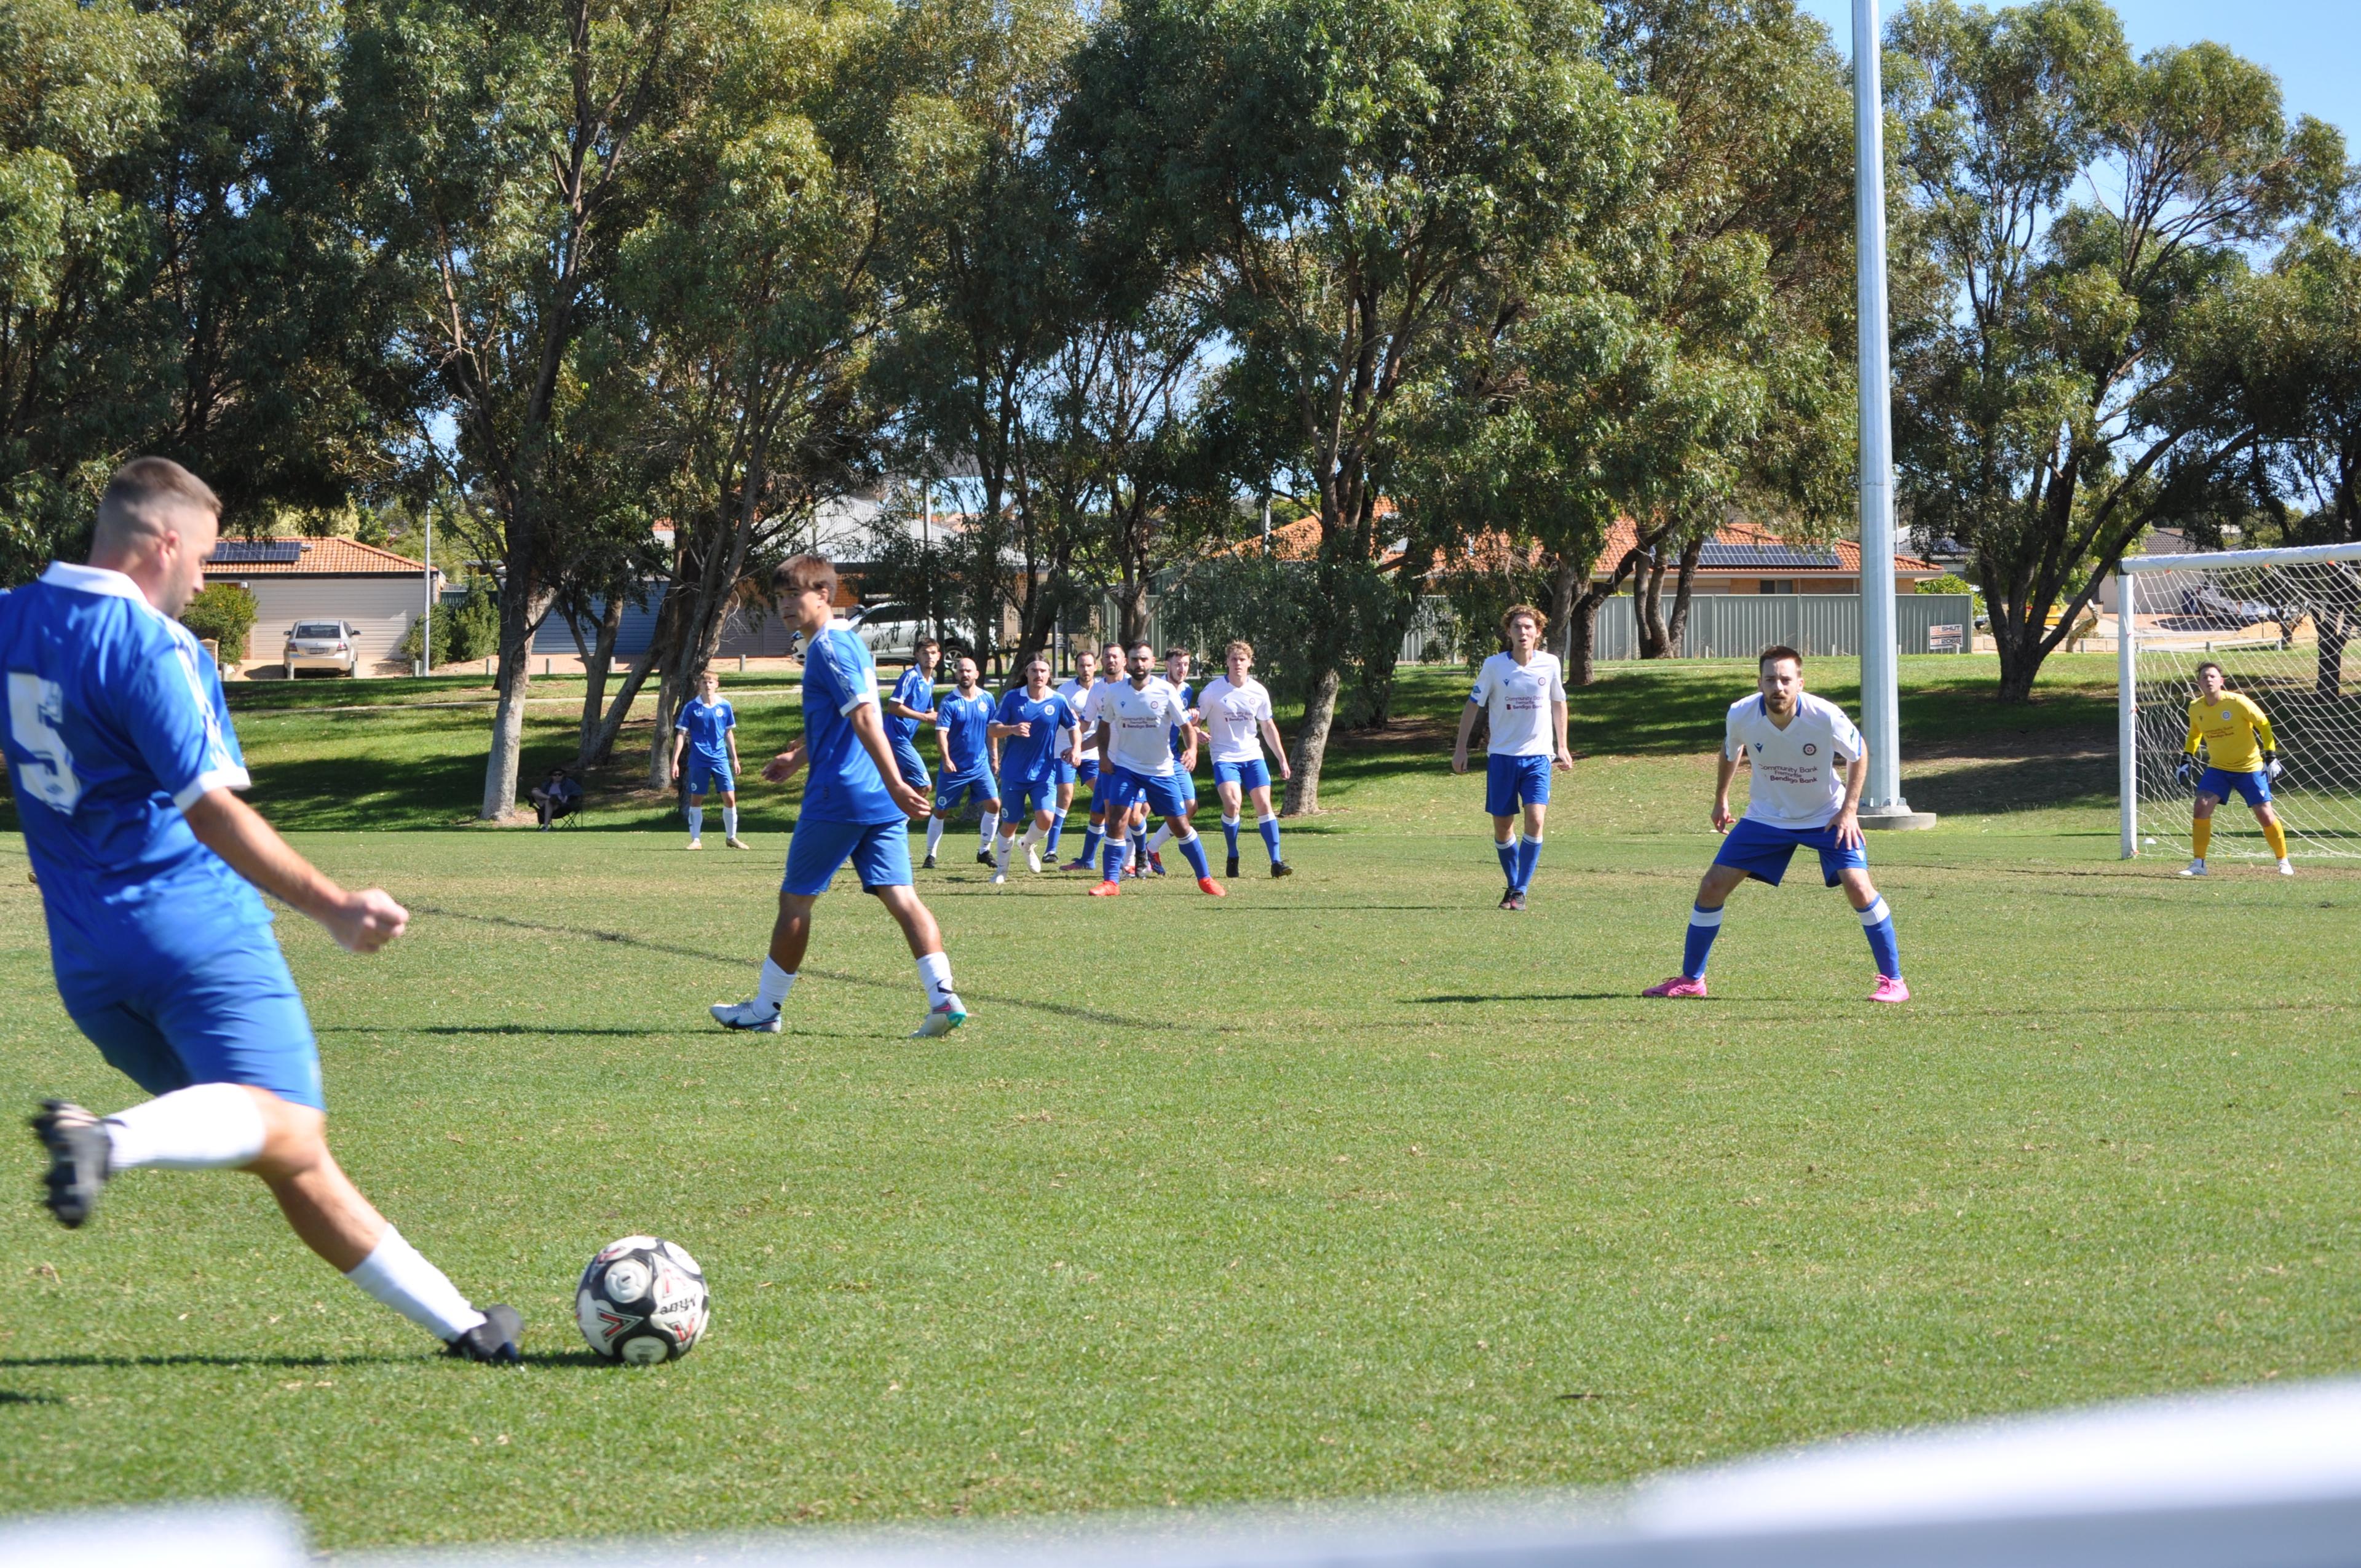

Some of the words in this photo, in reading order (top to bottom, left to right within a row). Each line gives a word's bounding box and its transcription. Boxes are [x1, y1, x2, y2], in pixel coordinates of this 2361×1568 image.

[7, 672, 82, 817] 5
[1758, 763, 1798, 774] Community
[1770, 775, 1798, 784] Bendigo
